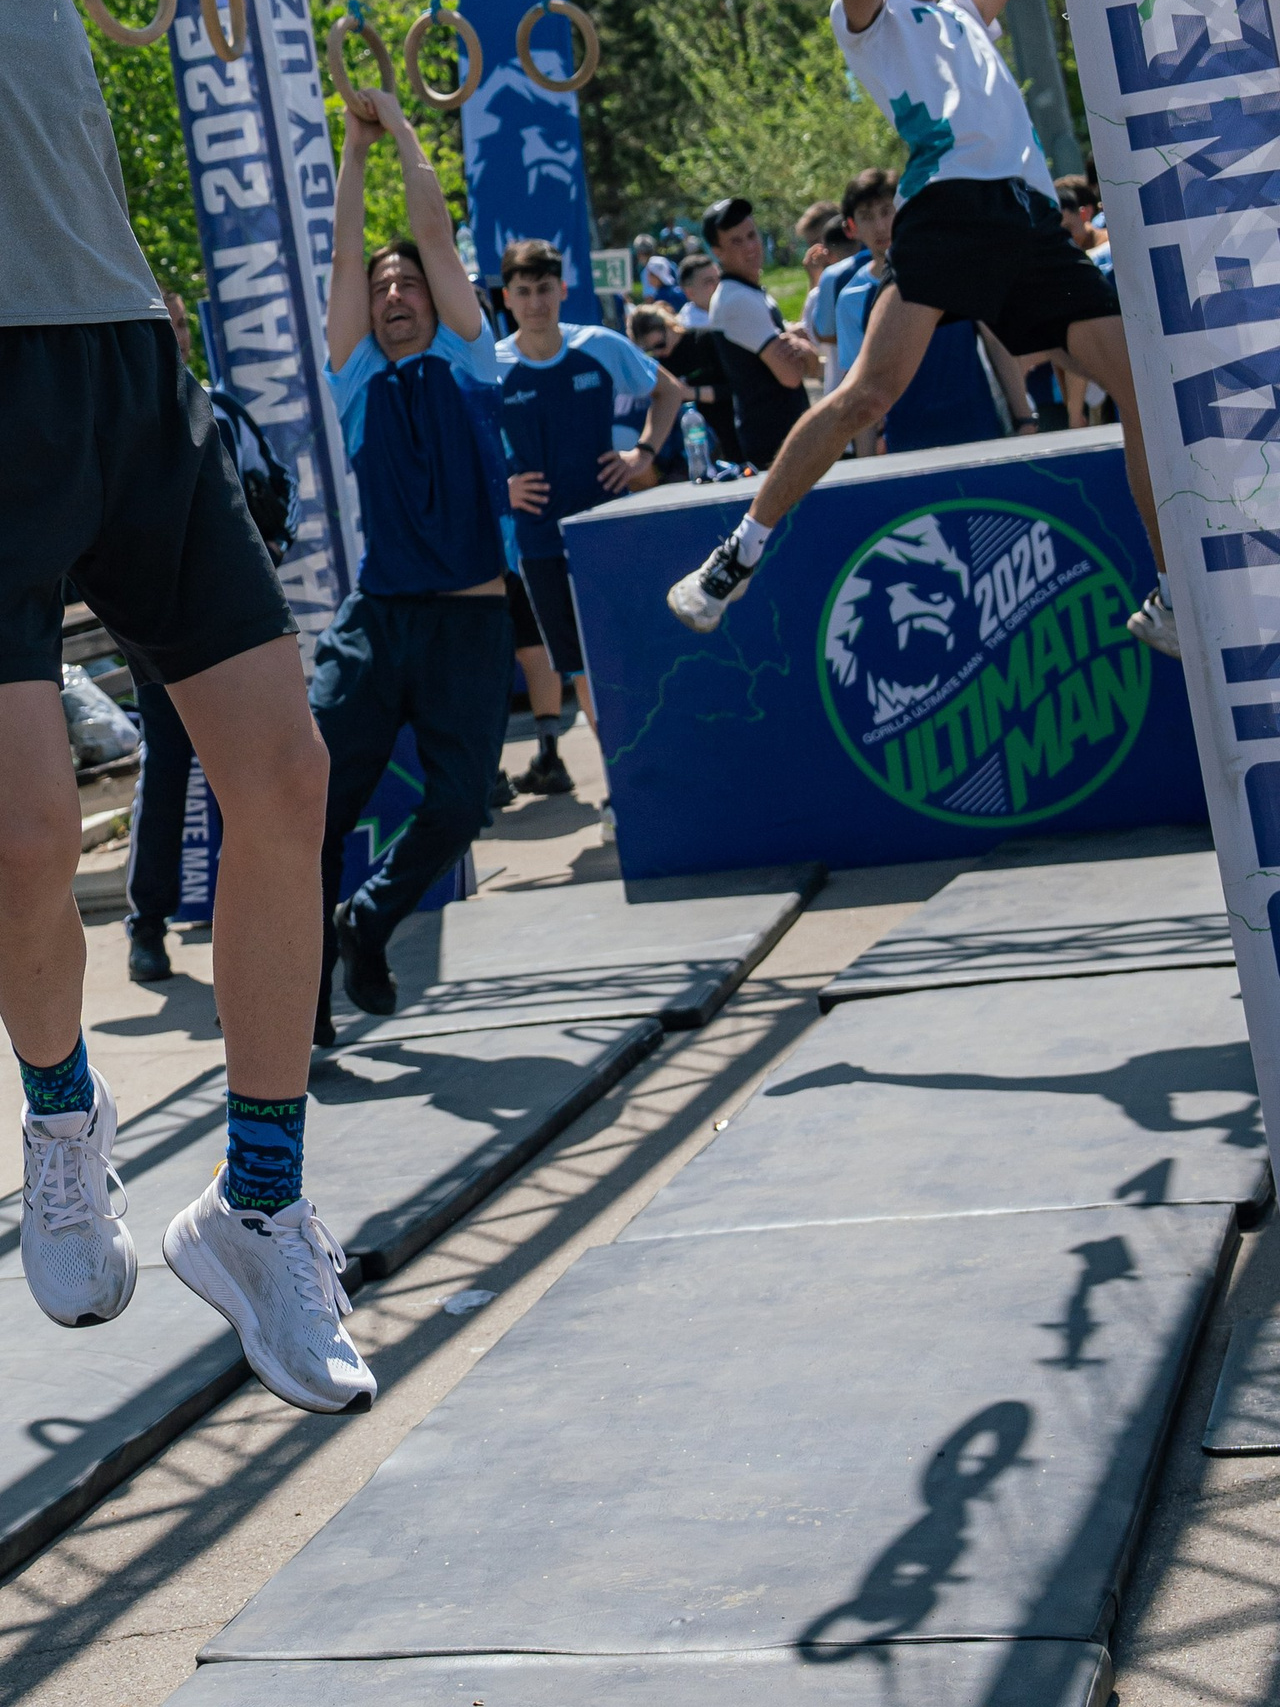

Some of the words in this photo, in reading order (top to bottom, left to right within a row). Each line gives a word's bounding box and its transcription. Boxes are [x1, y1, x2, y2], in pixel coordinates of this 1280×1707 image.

[213, 240, 304, 427] MAN
[862, 712, 913, 744] GORILLA
[911, 676, 962, 718] ULTIMATE
[984, 630, 1008, 650] THE
[1004, 581, 1059, 631] OBSTACLE
[1056, 559, 1092, 587] RACE
[973, 520, 1056, 641] 2026
[883, 574, 1136, 801] ULTIMATE
[1004, 646, 1145, 812] MAN
[181, 847, 209, 904] MAN
